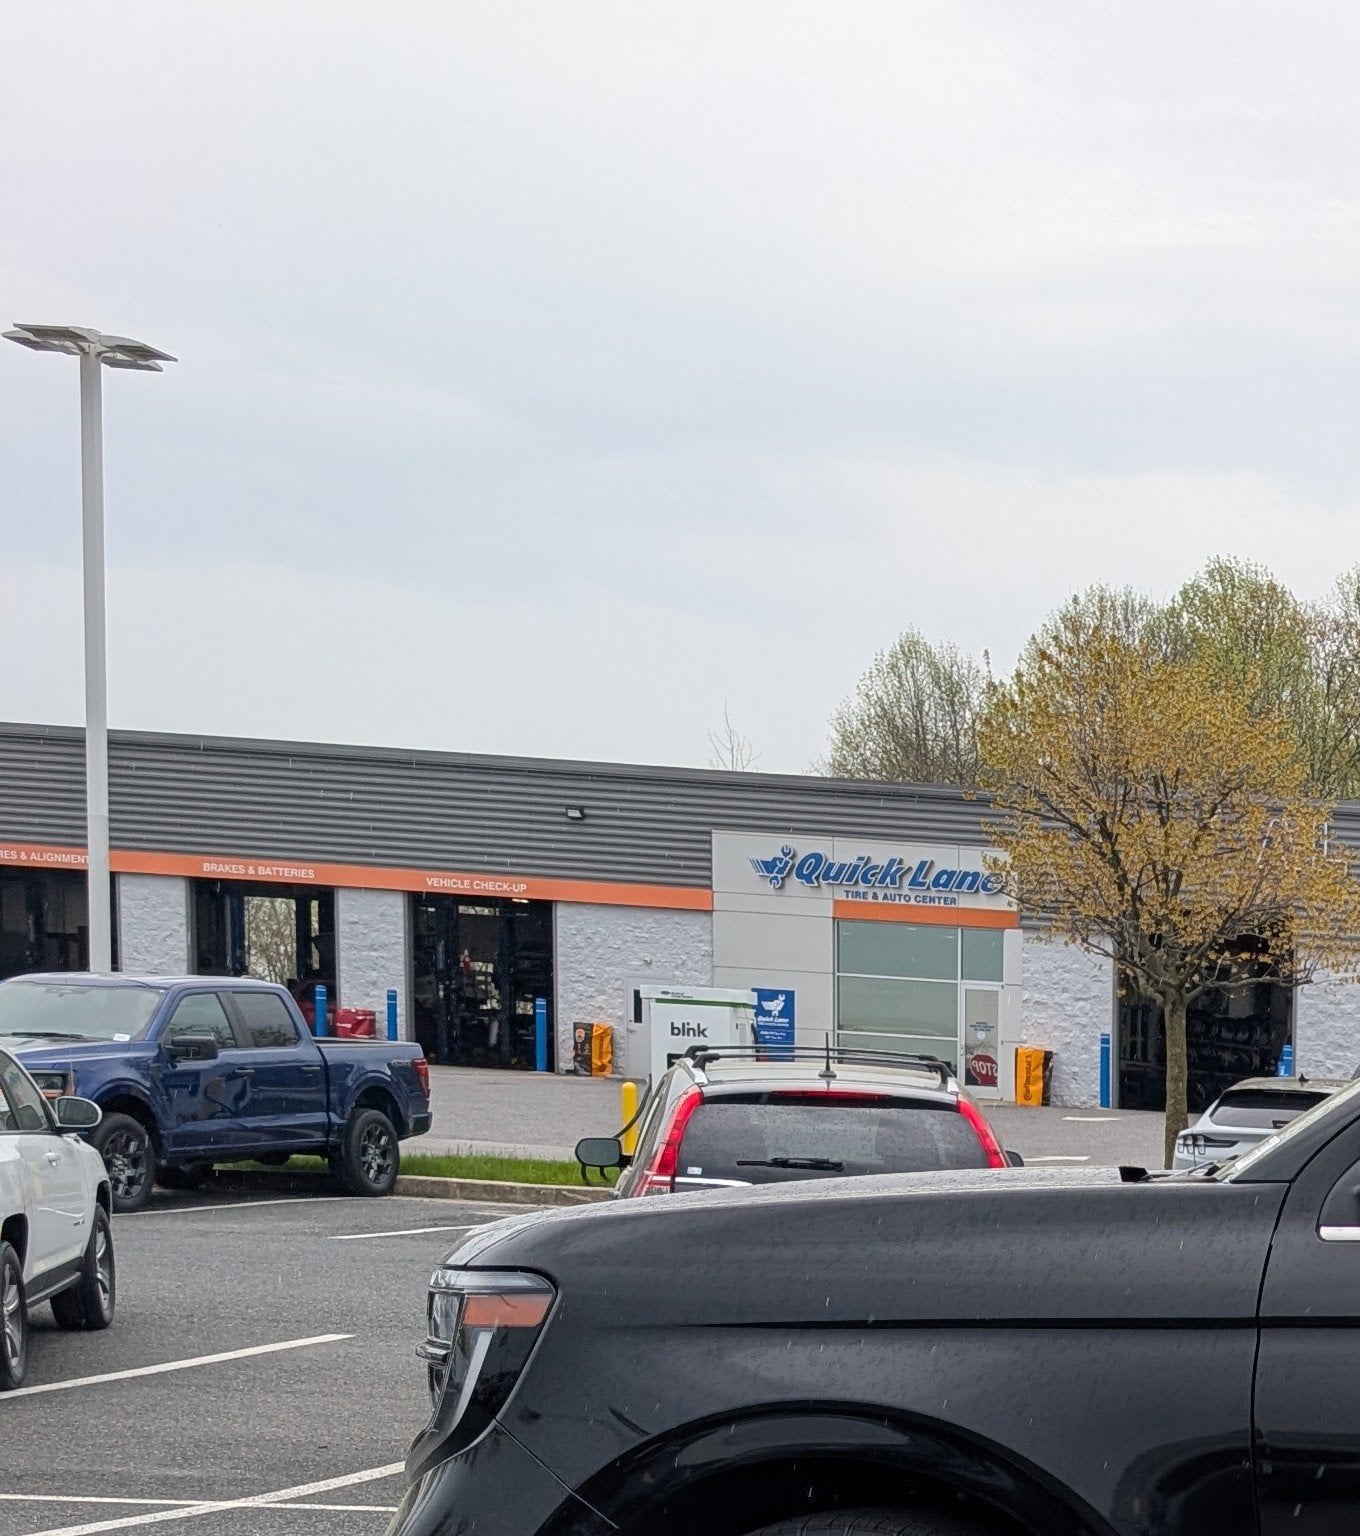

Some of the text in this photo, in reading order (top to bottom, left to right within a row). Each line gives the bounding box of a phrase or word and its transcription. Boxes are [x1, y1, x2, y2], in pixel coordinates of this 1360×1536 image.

[20, 851, 28, 860] &
[30, 852, 90, 863] ALIGNMENT
[203, 862, 315, 879] BRAKES & BATTERIES
[795, 852, 1004, 894] Quick Lane
[426, 877, 528, 893] VEHICLE CHECK-UP
[844, 889, 957, 906] TIRE & AUTO CENTER
[670, 1021, 708, 1038] blink
